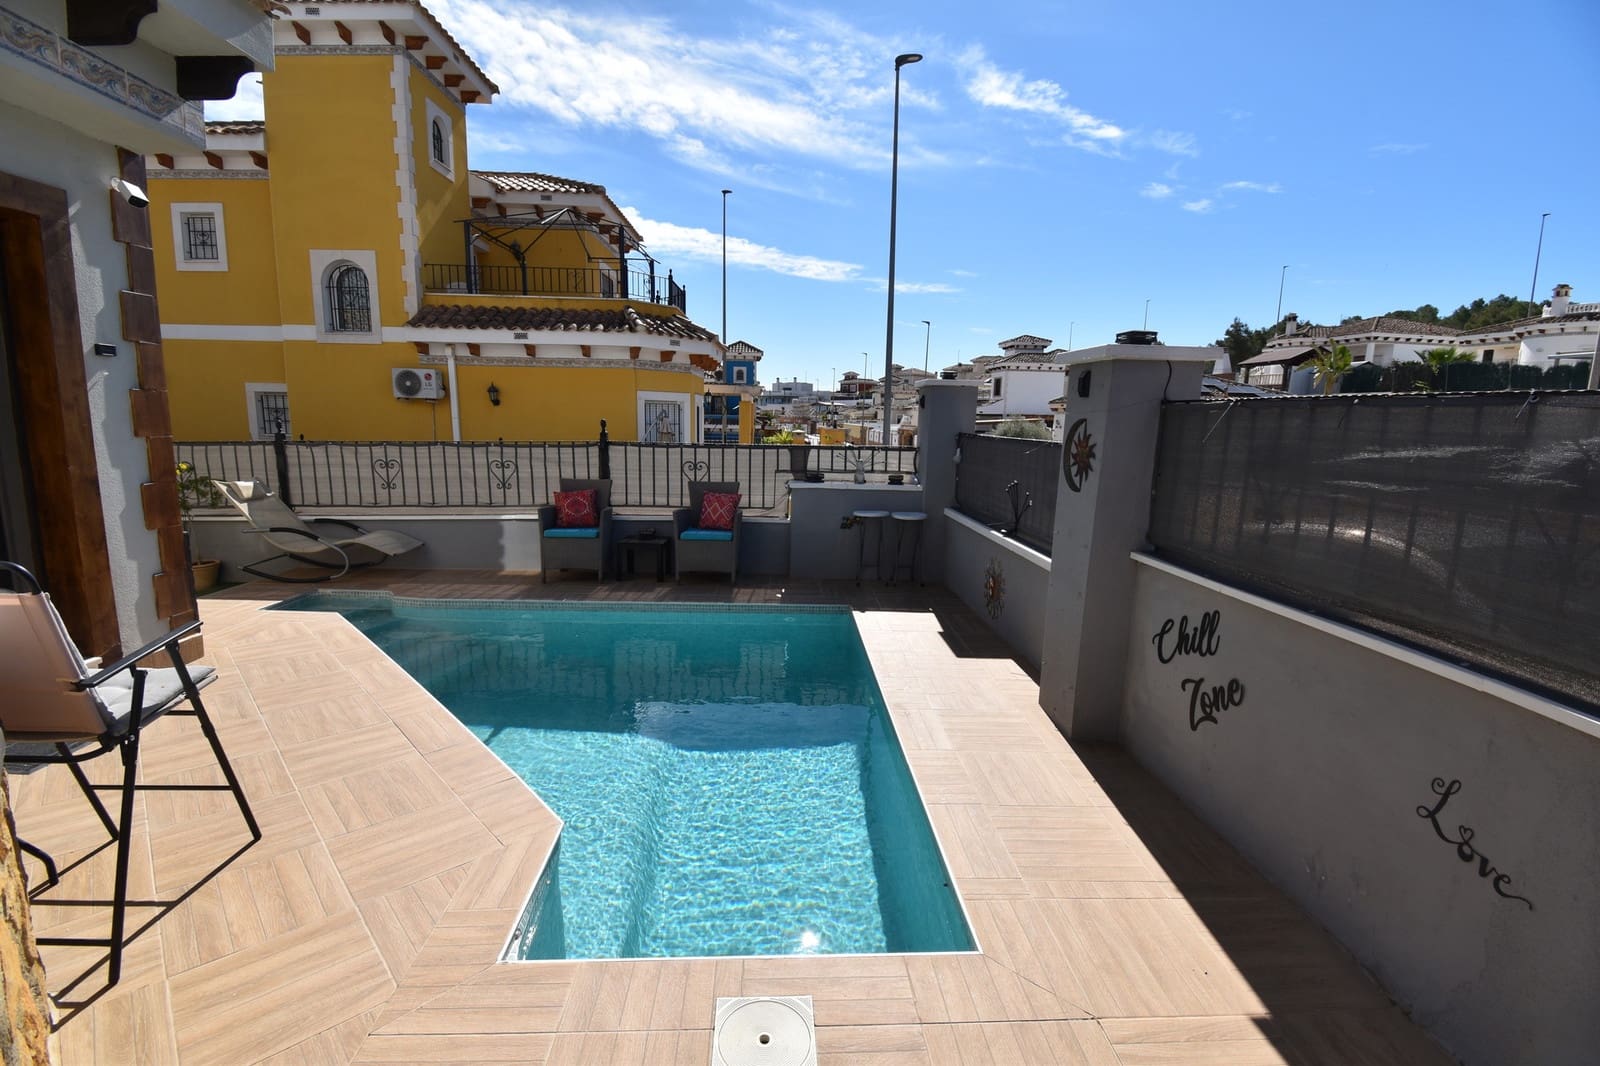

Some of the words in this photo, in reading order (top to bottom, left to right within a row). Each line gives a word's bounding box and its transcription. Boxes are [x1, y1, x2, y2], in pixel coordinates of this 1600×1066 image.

[1152, 610, 1221, 664] Chill
[1181, 677, 1246, 731] Zone
[1416, 777, 1533, 911] Love
